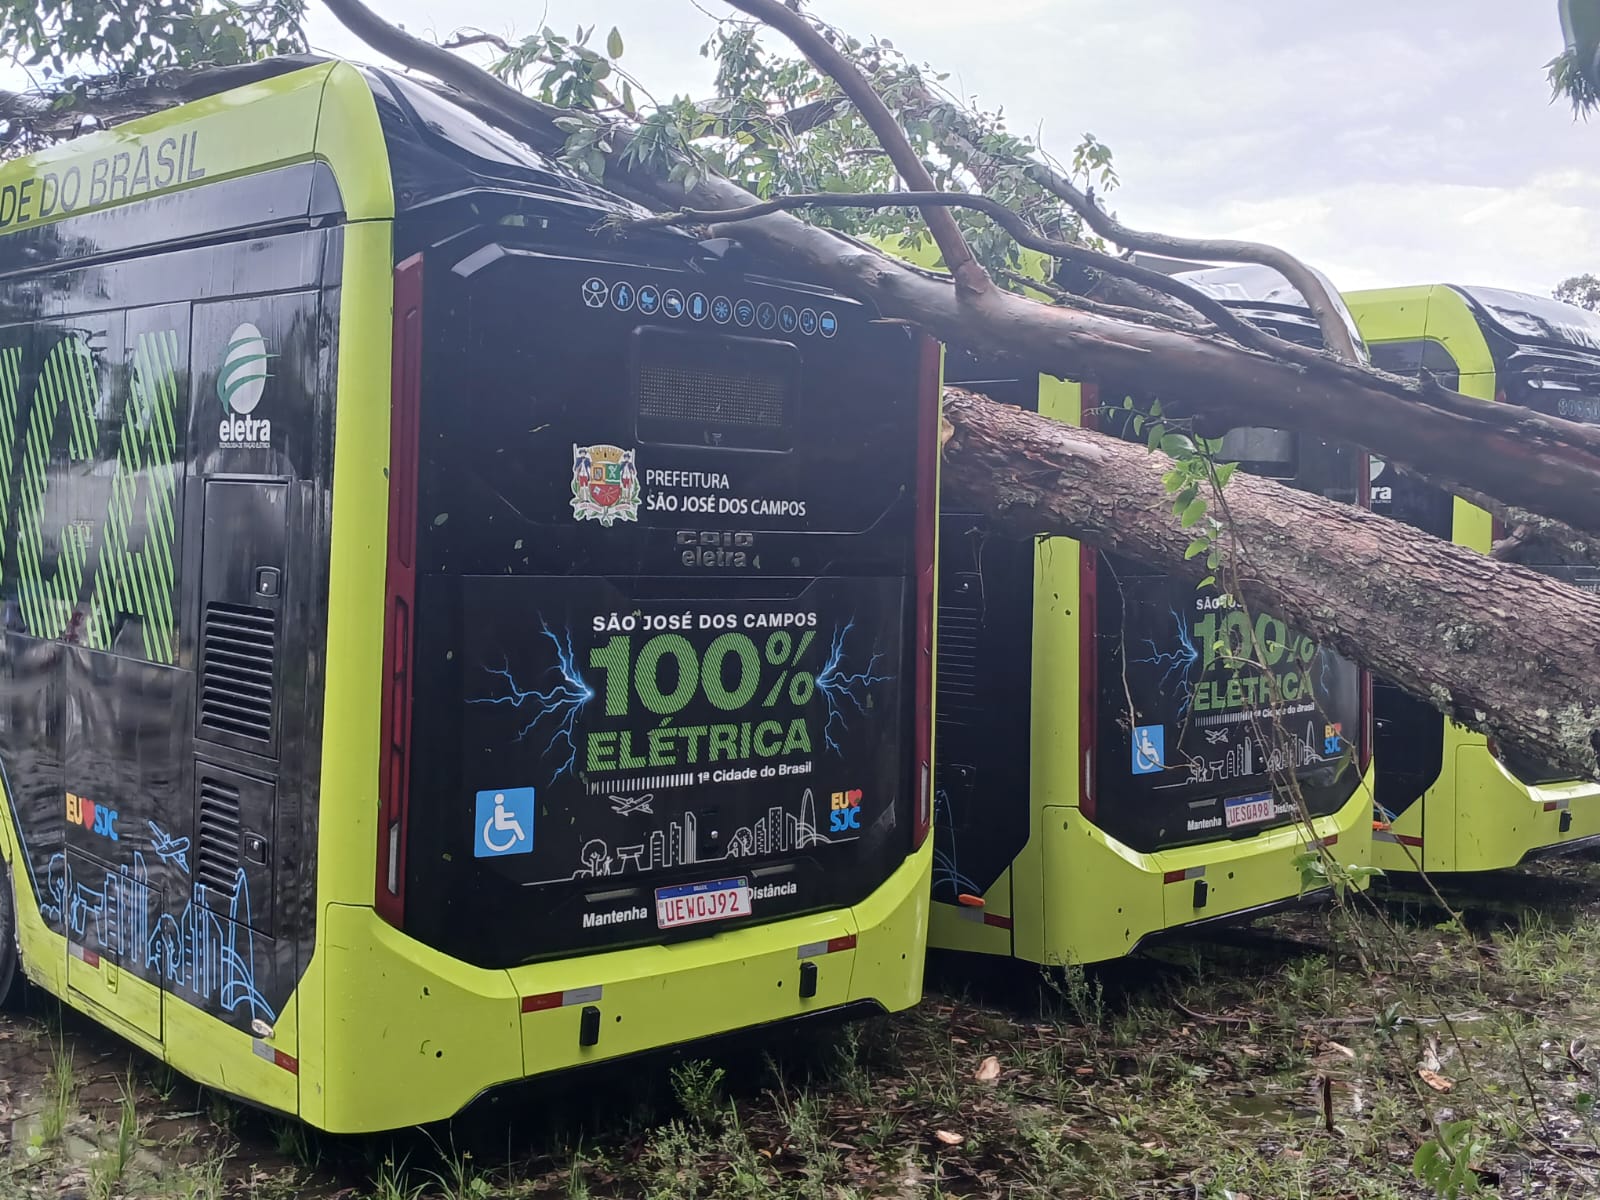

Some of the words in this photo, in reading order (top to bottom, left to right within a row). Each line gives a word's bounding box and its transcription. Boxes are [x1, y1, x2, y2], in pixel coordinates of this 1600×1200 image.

[39, 166, 81, 217] DO
[89, 130, 206, 206] BRASIL
[219, 413, 270, 441] eletra
[646, 469, 730, 489] PREFEITURA
[646, 491, 678, 512] SÃO
[681, 494, 716, 513] JOSÉ
[719, 498, 748, 514] DOS
[751, 499, 806, 517] CAMPOS
[682, 546, 746, 567] eletra
[592, 612, 636, 632] SÃO
[642, 611, 693, 631] JOSÉ
[699, 613, 738, 629] DOS
[743, 612, 817, 628] CAMPOS
[589, 630, 817, 717] 100%
[586, 716, 813, 773] ELÉTRICA
[1325, 737, 1341, 754] SJC
[697, 772, 710, 785] 1ª
[713, 766, 758, 784] Cidade
[760, 764, 776, 779] do
[778, 761, 812, 777] Brasil
[832, 791, 850, 810] EU
[66, 792, 83, 825] EU
[94, 804, 119, 841] SJC
[830, 806, 860, 832] SJC
[1187, 816, 1222, 831] Mantenha
[582, 906, 648, 928] Mantenha
[748, 882, 797, 900] Distância
